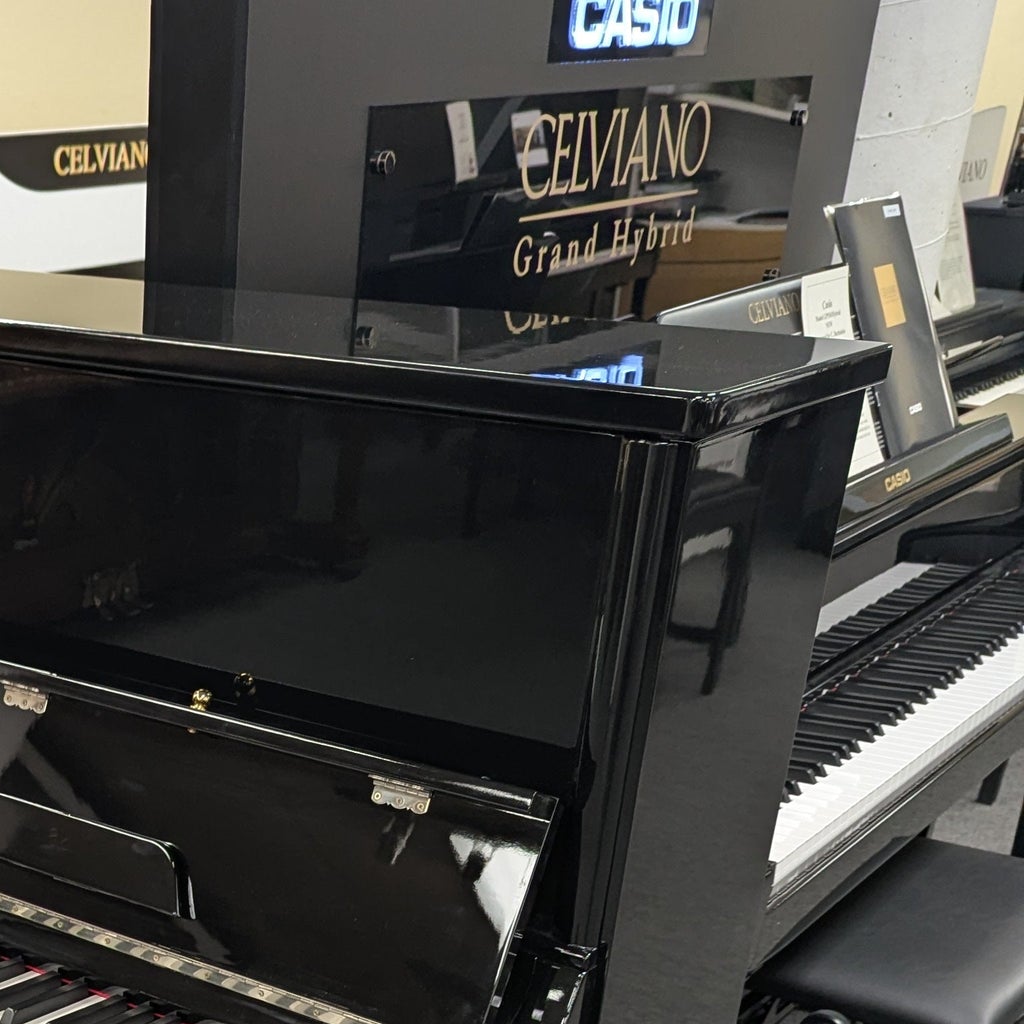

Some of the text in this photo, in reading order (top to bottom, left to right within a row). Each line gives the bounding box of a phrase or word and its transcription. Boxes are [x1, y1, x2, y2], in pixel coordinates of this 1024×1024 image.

[568, 0, 699, 49] CASIO
[521, 100, 711, 200] CELVIANO
[513, 205, 696, 277] Grand Hybrid
[748, 292, 800, 324] CELVIANO
[884, 467, 912, 492] CASIO
